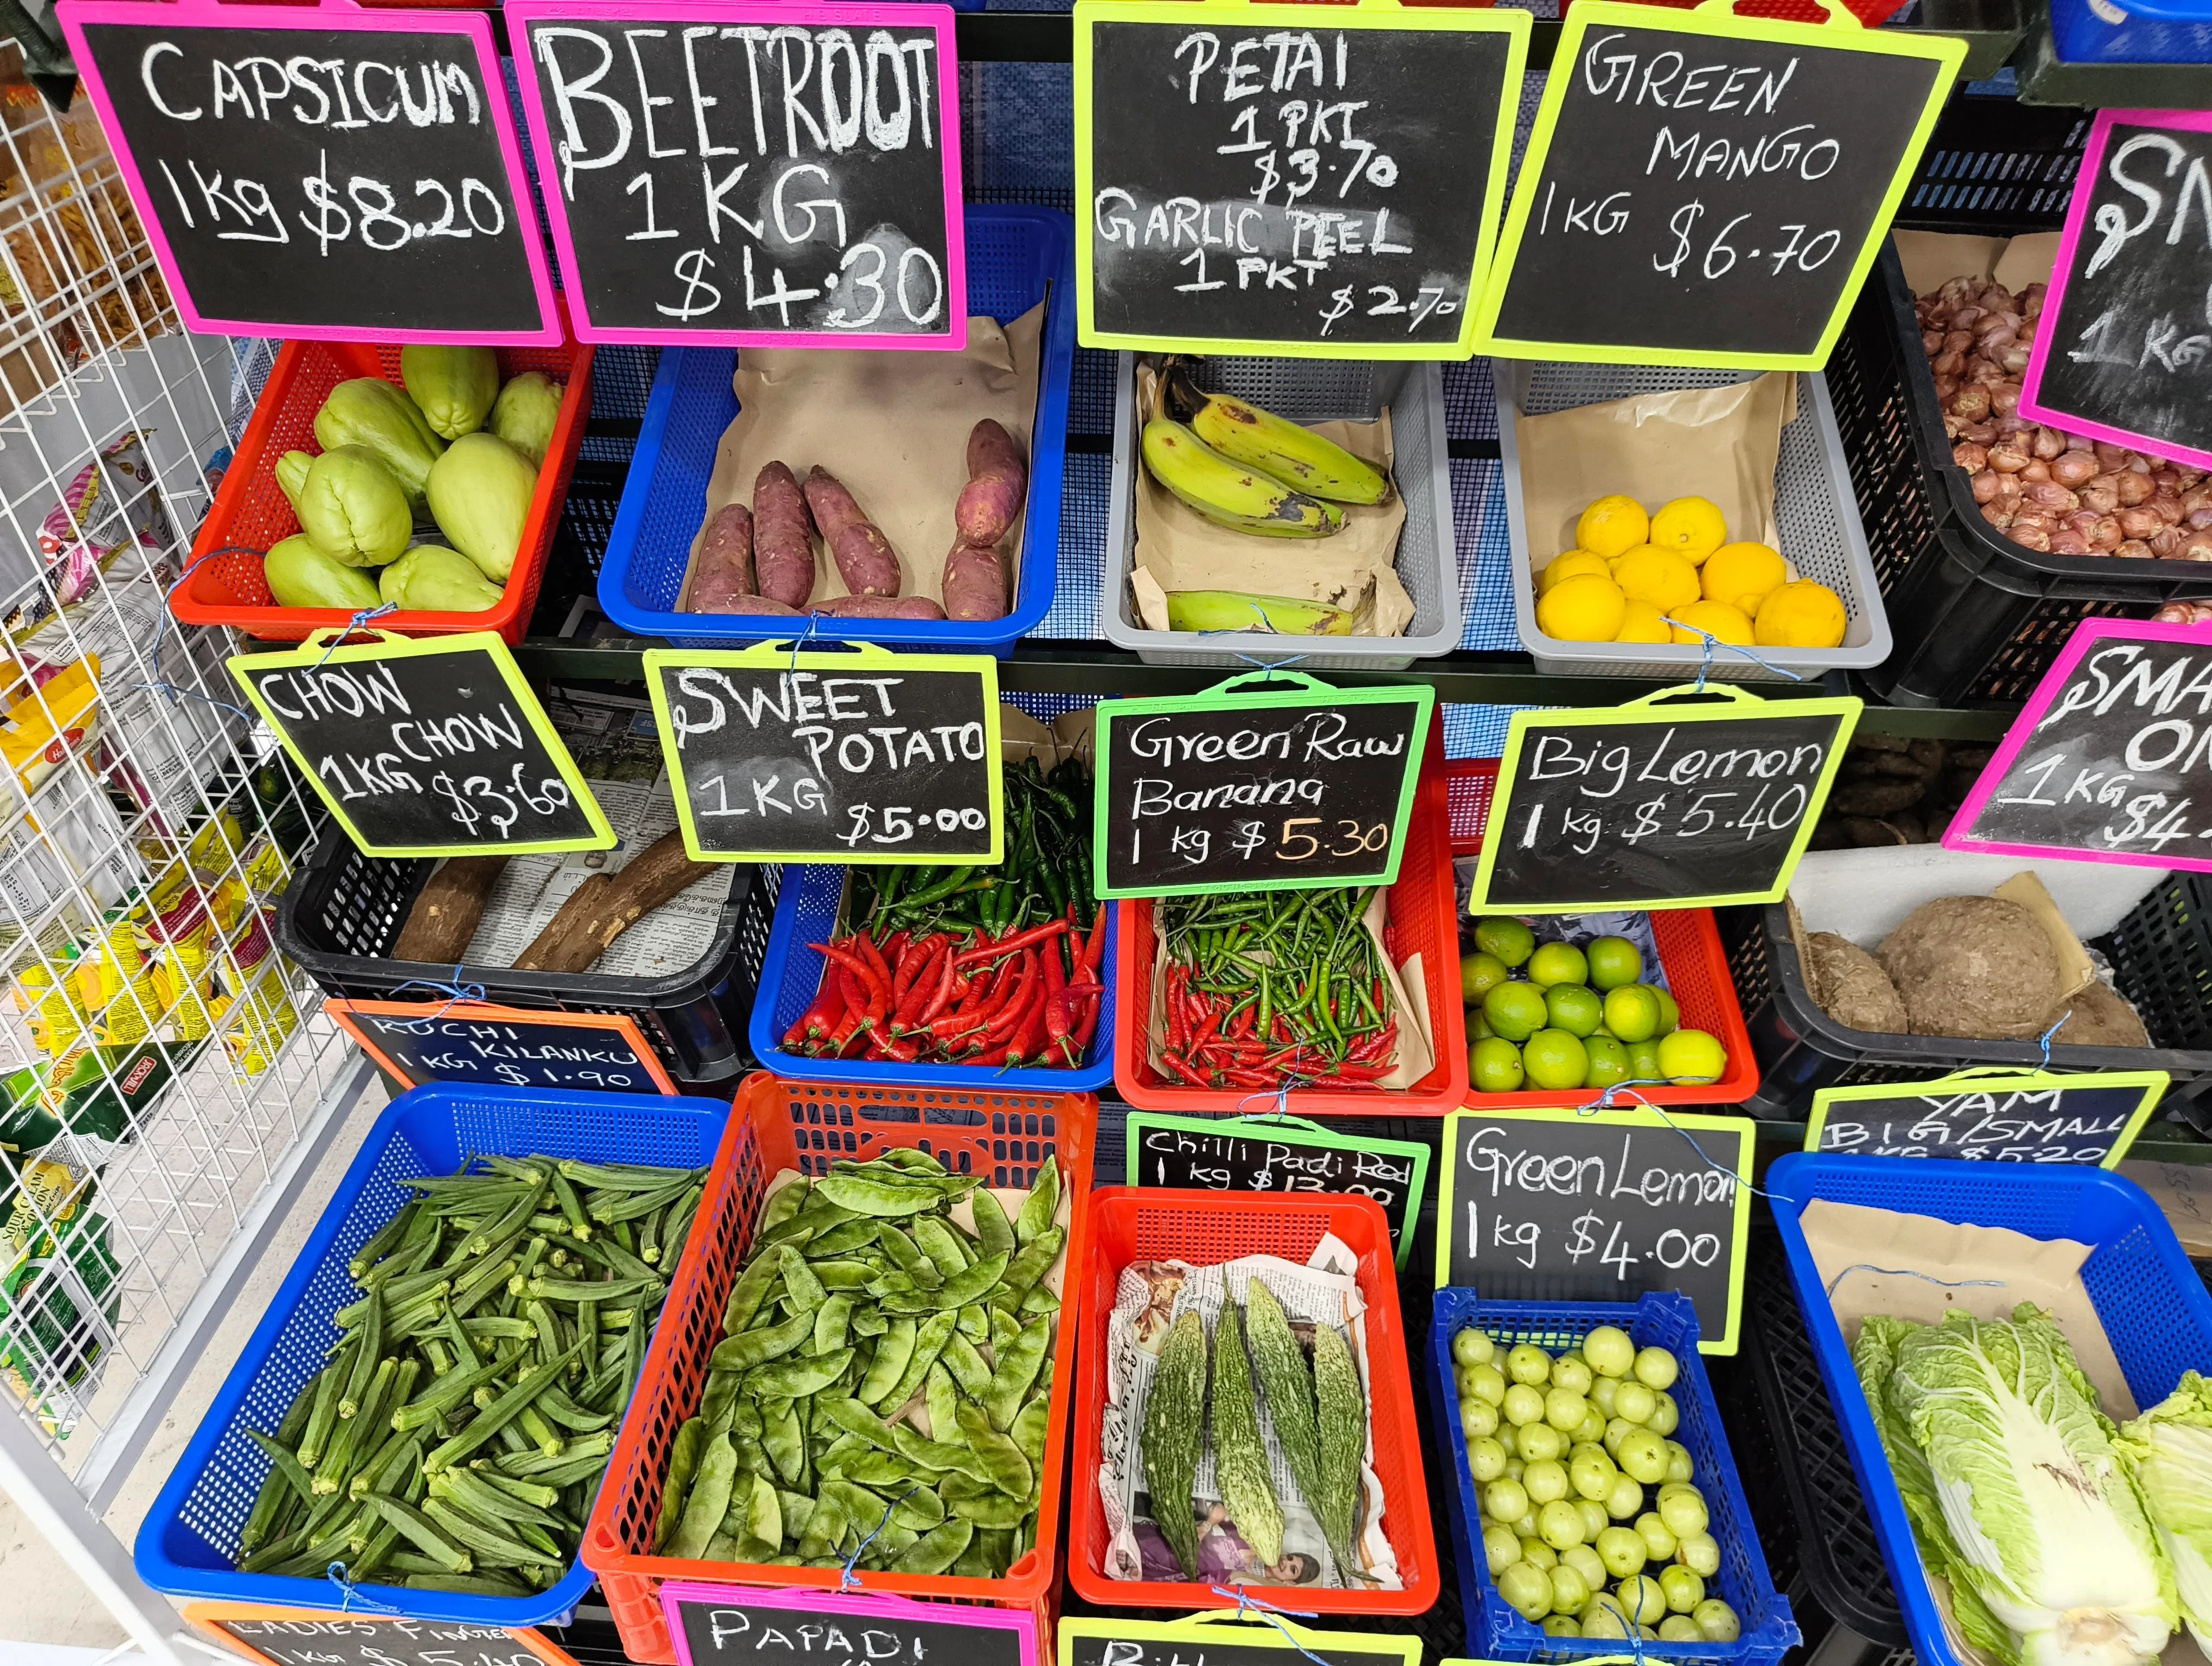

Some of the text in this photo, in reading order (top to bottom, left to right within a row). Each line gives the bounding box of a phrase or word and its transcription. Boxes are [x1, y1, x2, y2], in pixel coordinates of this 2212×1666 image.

[141, 41, 481, 127] CAPSICUM
[1174, 30, 1349, 105] PETAI
[1585, 33, 1801, 117] GREEN
[533, 24, 934, 201] BEETROOT
[1217, 99, 1377, 156] 1 PKT
[1646, 124, 1841, 181] MANGO
[299, 149, 504, 257] $8.20
[625, 161, 847, 247] 1 KG
[1095, 186, 1413, 262] GARLIC PEEL
[1653, 198, 1841, 279] $6.70
[1173, 247, 1329, 292] 1 PKT
[259, 661, 412, 721] CHOW
[672, 668, 905, 749] SWEET
[391, 703, 525, 762] CHOW
[792, 721, 985, 782] POTATO
[1130, 710, 1406, 768] Green Raw
[1528, 727, 1822, 798] Big Lemon
[432, 762, 571, 840] $3.60
[835, 802, 987, 848] $5.00
[1131, 776, 1325, 821] Banana
[1522, 803, 1544, 849] 1
[1132, 828, 1141, 864] 1
[373, 1018, 520, 1040] KUCHI
[468, 1040, 638, 1065] KILANKU
[1916, 1088, 2064, 1122] YAM
[1158, 1157, 1165, 1186] 1
[1265, 1143, 1343, 1178] Padi
[1466, 1126, 1734, 1208] Green Lemon
[20, 1172, 45, 1208] CEAM
[1468, 1200, 1478, 1259] 1
[1565, 1208, 1721, 1281] $4.00
[226, 1620, 377, 1636] LADIES
[710, 1610, 928, 1660] PAPADI
